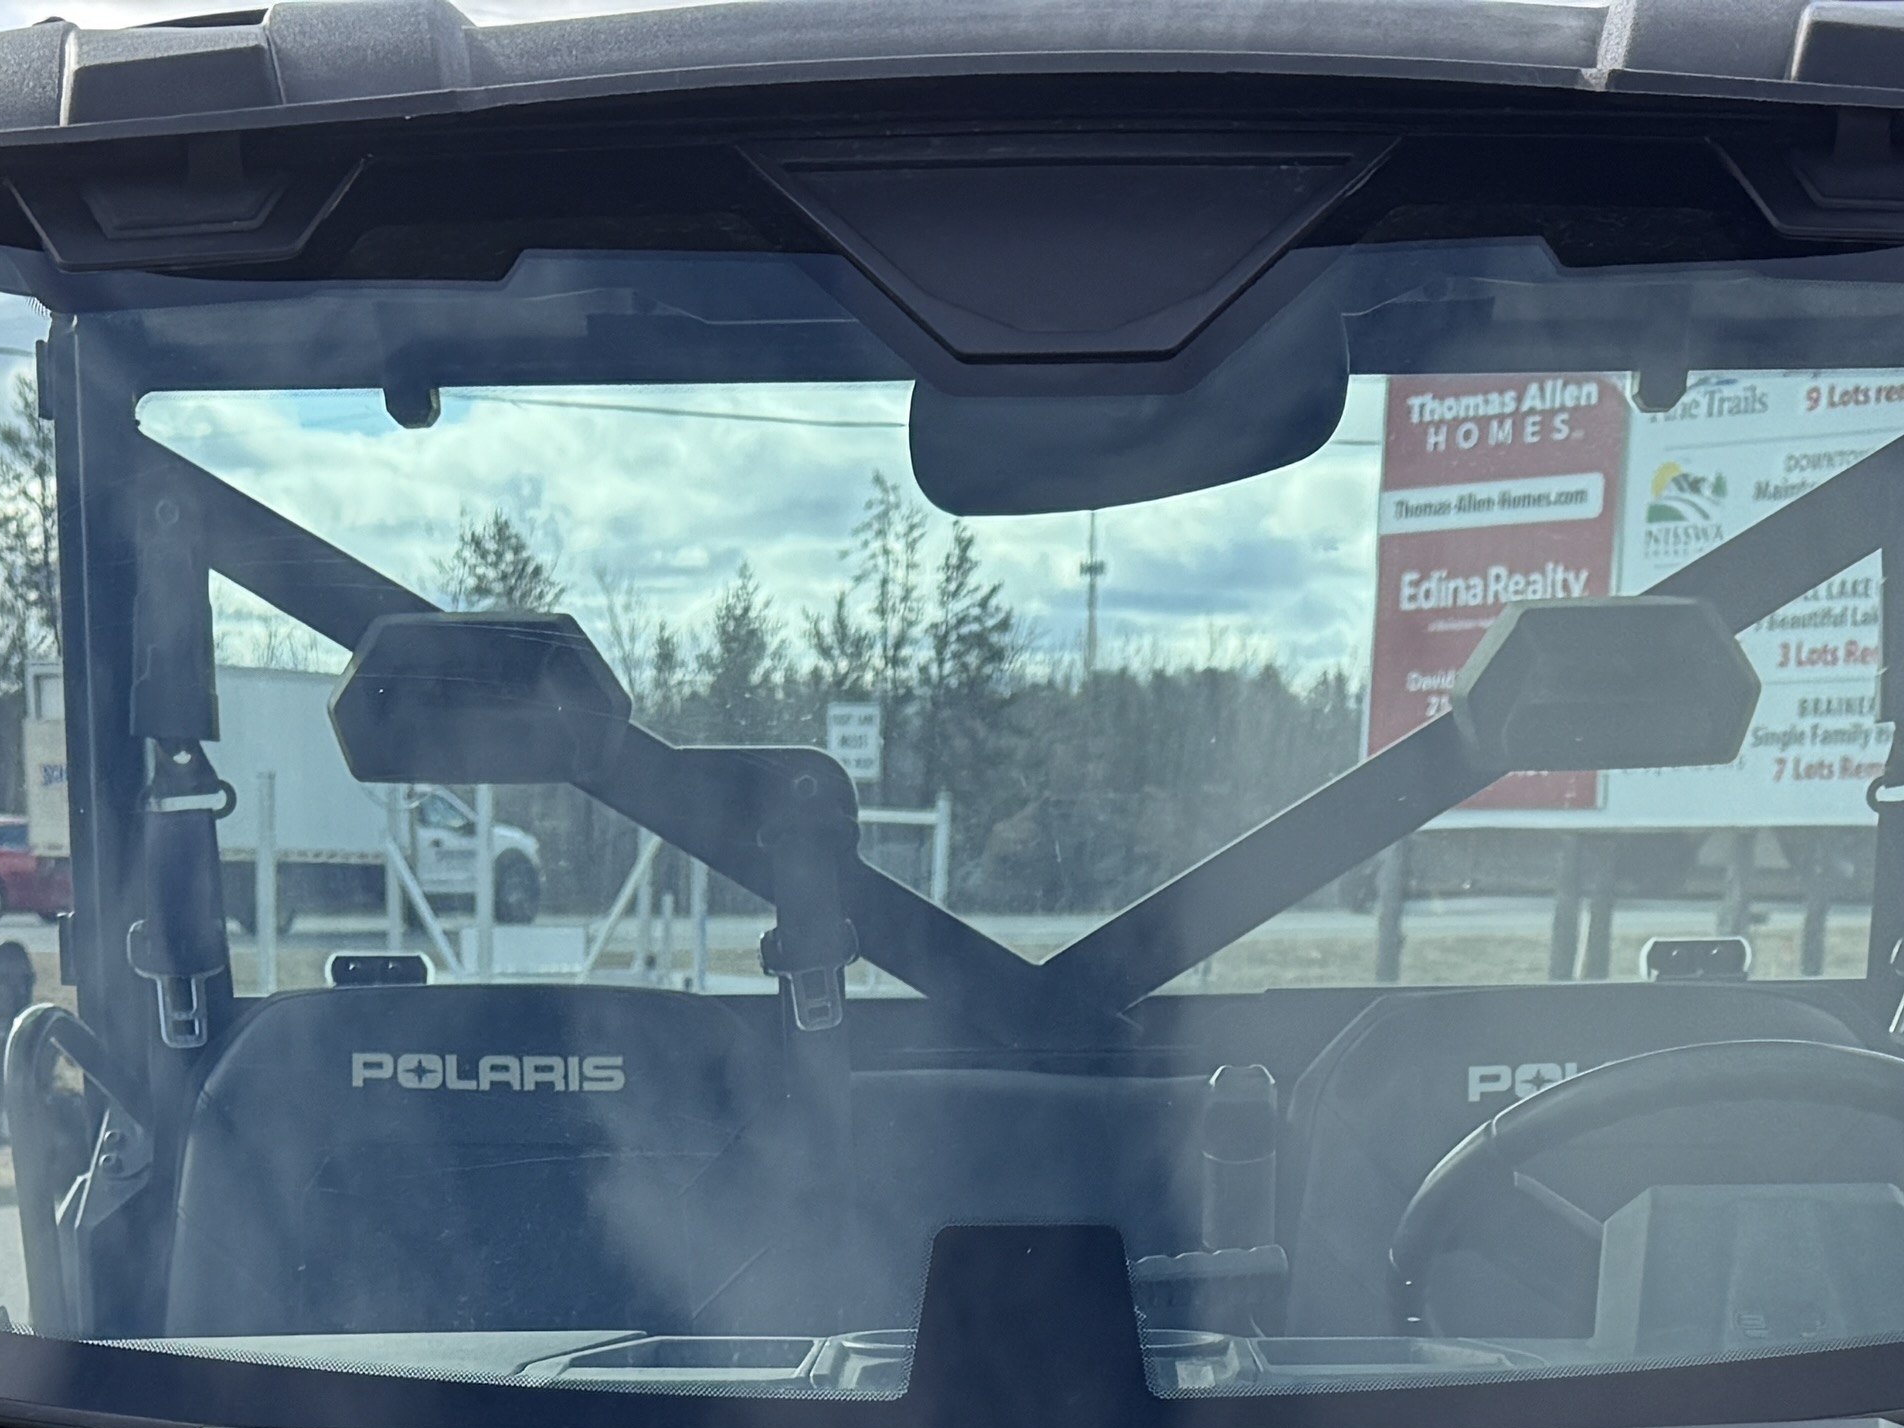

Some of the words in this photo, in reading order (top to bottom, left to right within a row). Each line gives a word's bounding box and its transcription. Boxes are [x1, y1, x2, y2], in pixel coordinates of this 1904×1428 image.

[1406, 389, 1518, 424] Thomas
[1521, 379, 1599, 412] Allen
[1703, 384, 1769, 417] Trails
[1805, 385, 1821, 411] 9
[1826, 383, 1870, 408] Lots
[1426, 412, 1570, 452] HOMES
[1400, 569, 1485, 611] Edina
[1487, 562, 1589, 602] Realty
[1795, 640, 1840, 667] Lots
[1791, 756, 1834, 781] Lots
[351, 1052, 626, 1092] POLARIS
